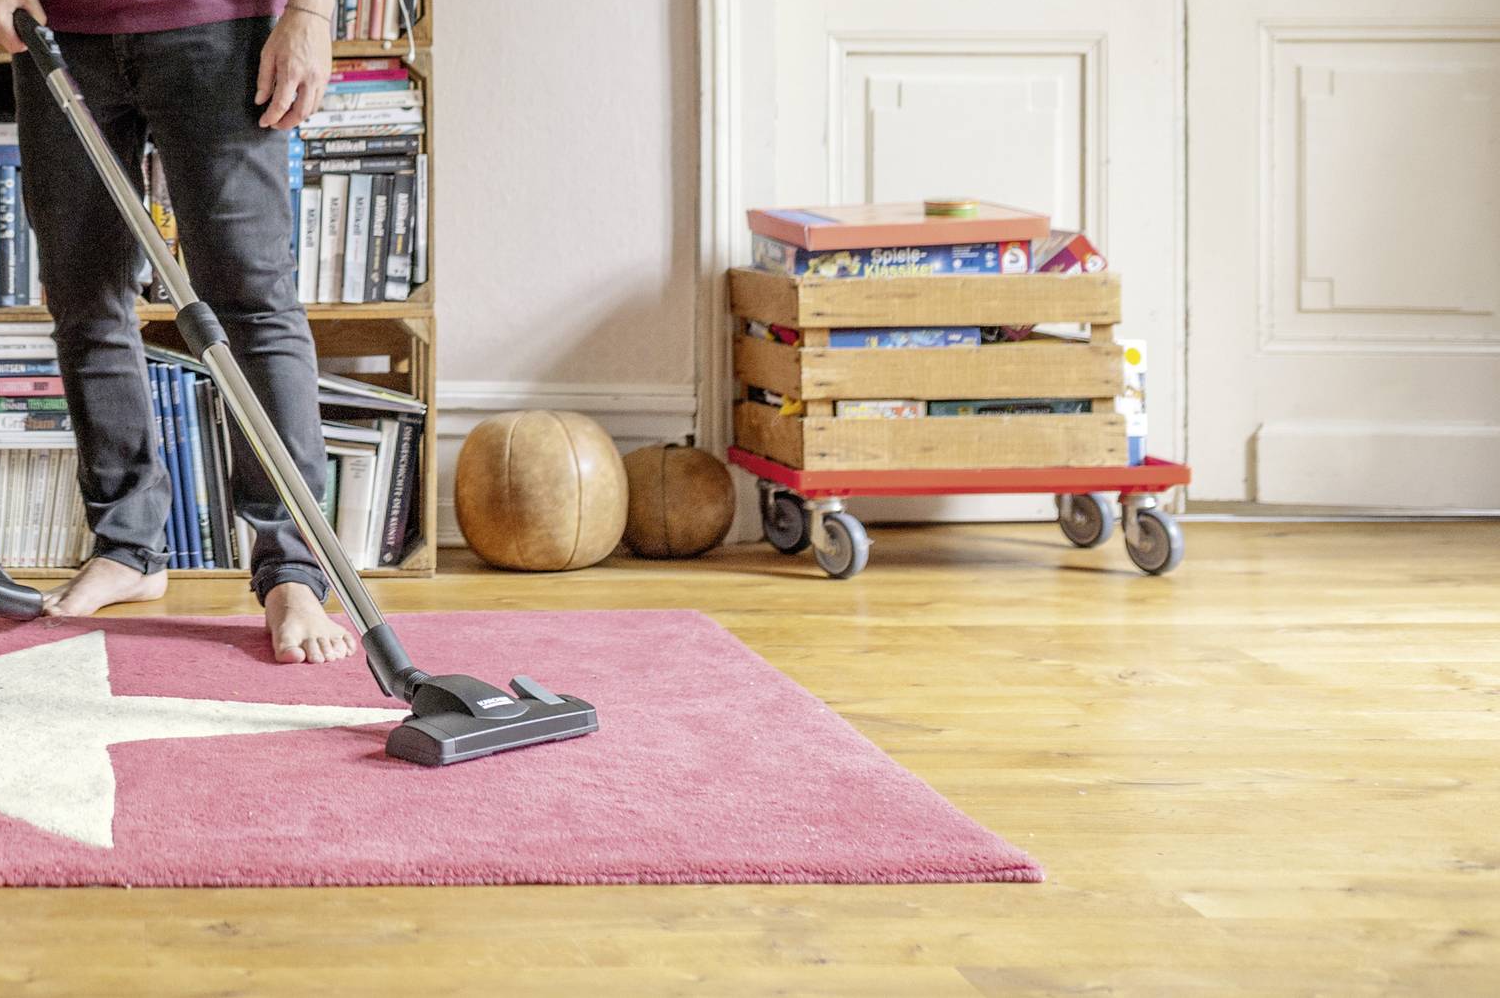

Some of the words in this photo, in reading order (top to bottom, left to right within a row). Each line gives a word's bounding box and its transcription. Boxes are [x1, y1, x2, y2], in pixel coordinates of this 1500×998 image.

[306, 208, 314, 248] Mankell
[331, 197, 339, 236] Mankell
[355, 196, 364, 235] Mankell
[870, 248, 927, 265] Spiele-
[394, 441, 411, 496] GESCHICHTE
[385, 516, 399, 546] KUNST
